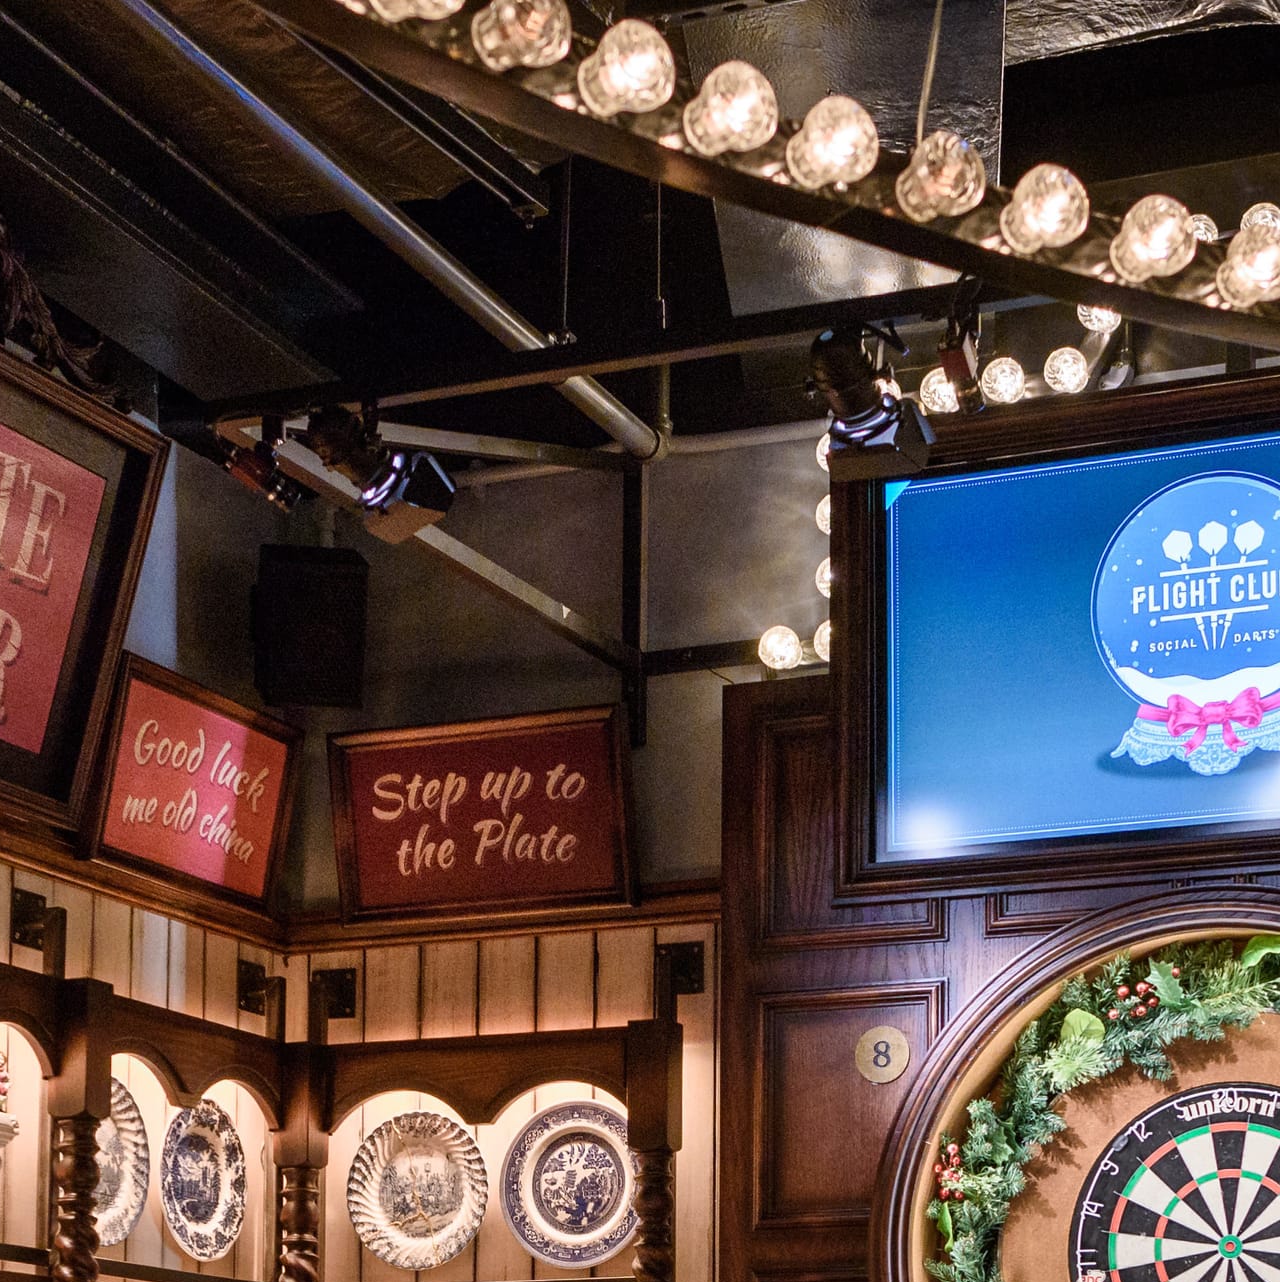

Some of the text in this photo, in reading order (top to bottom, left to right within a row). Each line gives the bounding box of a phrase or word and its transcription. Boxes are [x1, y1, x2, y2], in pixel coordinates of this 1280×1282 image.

[1131, 575, 1221, 614] FLIGHT
[1149, 638, 1197, 653] SOCIAL
[134, 719, 269, 813] Good luck
[371, 763, 587, 823] Step up to
[122, 787, 255, 864] me old china
[396, 814, 578, 877] the Plate
[872, 1040, 892, 1068] 8
[1128, 1120, 1153, 1142] 12
[1101, 1159, 1119, 1176] 9
[1082, 1201, 1104, 1219] 14
[1076, 1248, 1098, 1269] 11
